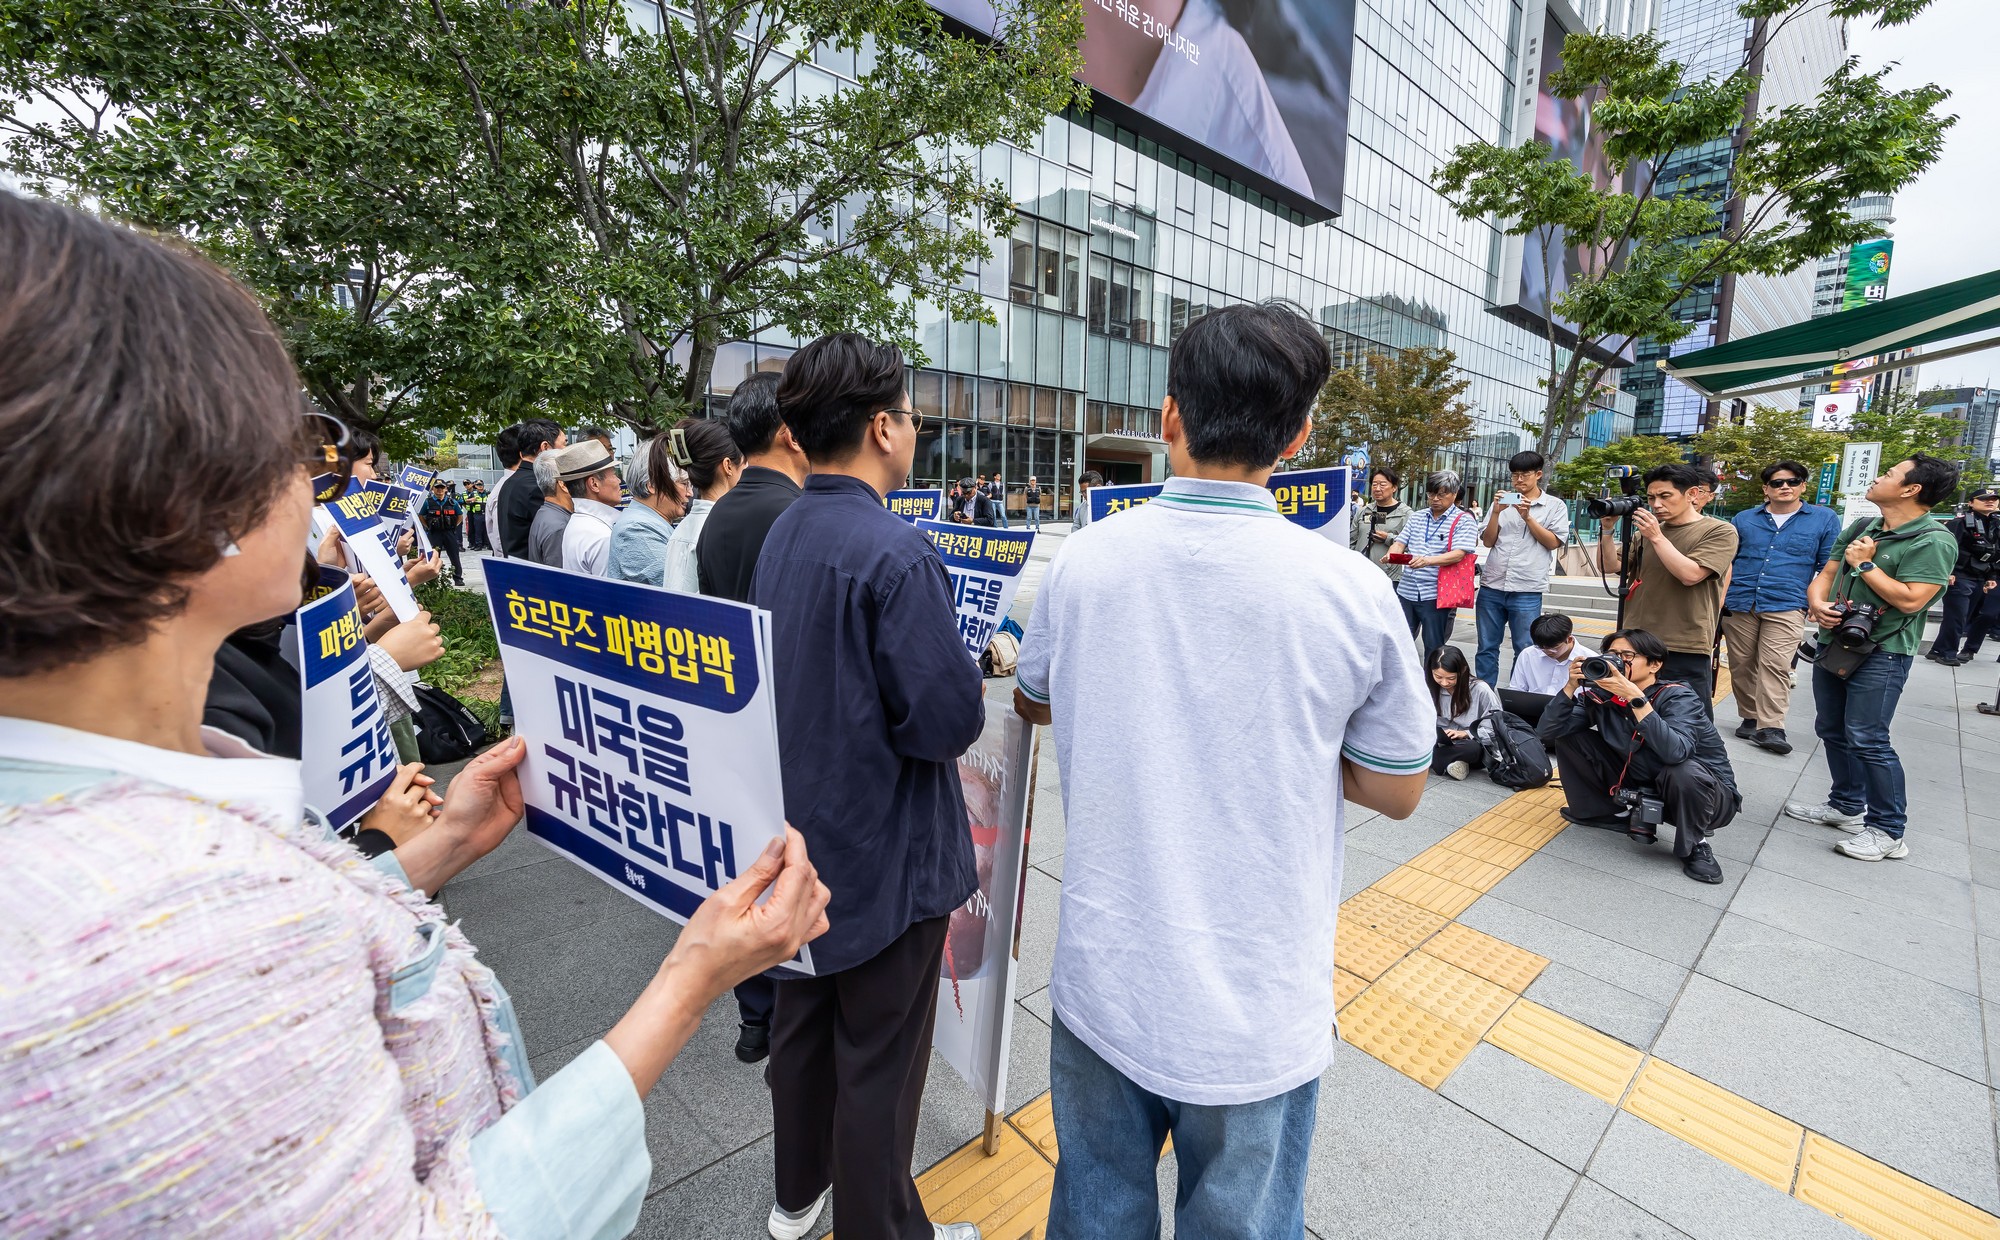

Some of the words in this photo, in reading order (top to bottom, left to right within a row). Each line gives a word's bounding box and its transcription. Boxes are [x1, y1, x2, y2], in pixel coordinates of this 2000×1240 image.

[1143, 12, 1154, 37] 건
[1156, 22, 1200, 65] 아니지만
[1113, 428, 1153, 439] STARBUCKS
[1858, 449, 1871, 487] 세종이야기
[891, 497, 934, 516] 파병압박
[1270, 483, 1329, 515] 압박
[984, 539, 1028, 565] 파병압박
[505, 590, 599, 653] 호르무즈
[603, 615, 735, 695] 파병압박
[554, 674, 692, 796] 미국을
